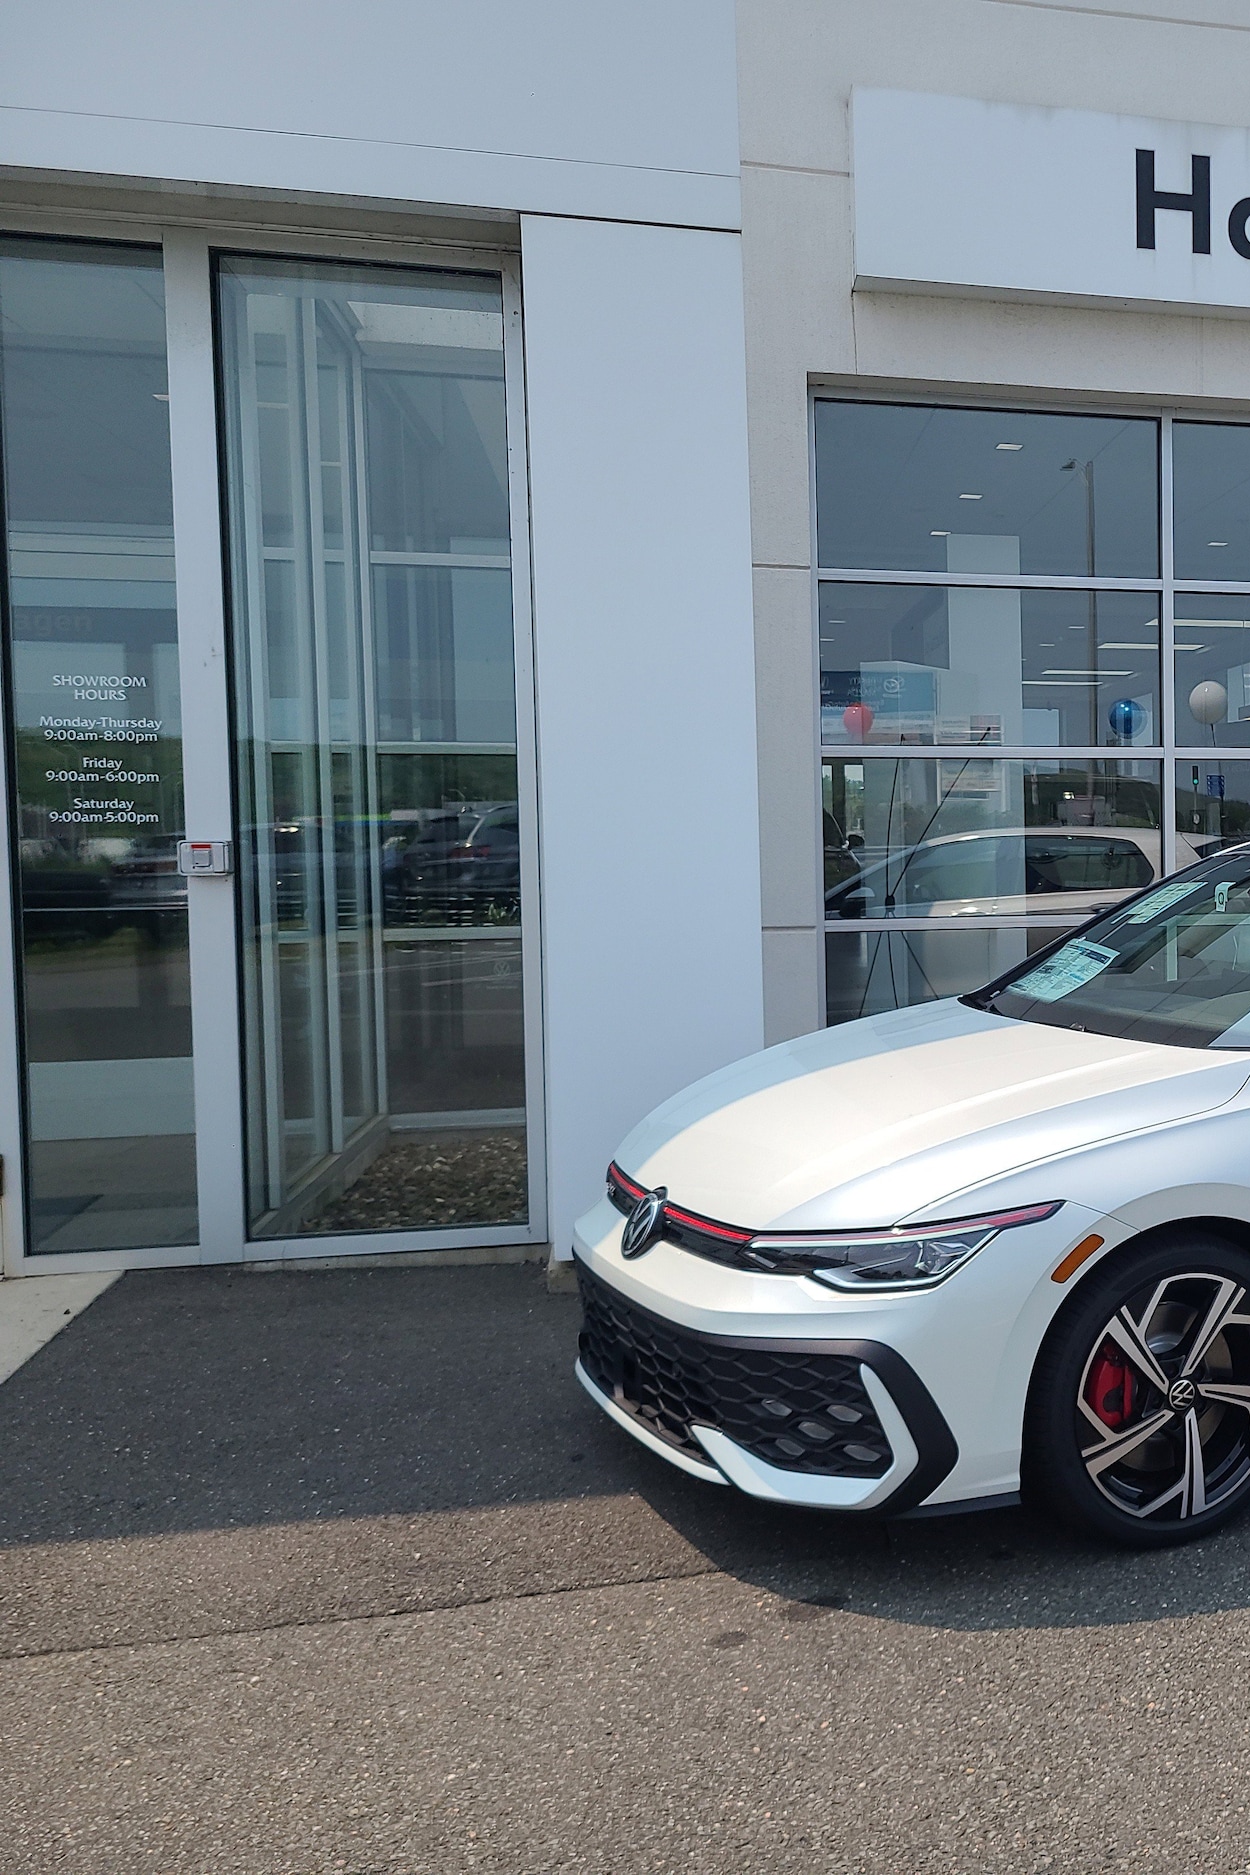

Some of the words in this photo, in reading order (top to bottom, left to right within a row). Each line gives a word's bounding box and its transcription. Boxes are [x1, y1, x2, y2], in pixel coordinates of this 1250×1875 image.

[53, 675, 146, 688] SHOWROOM
[74, 689, 127, 701] HOURS
[40, 716, 162, 730] Monday-Thursday
[44, 730, 158, 743] 9:00am-8:00pm
[83, 757, 123, 770] Friday
[45, 771, 160, 784] 9:00am-6:00pm
[73, 798, 135, 810] Saturday
[49, 812, 159, 825] 9:00am-5:00pm
